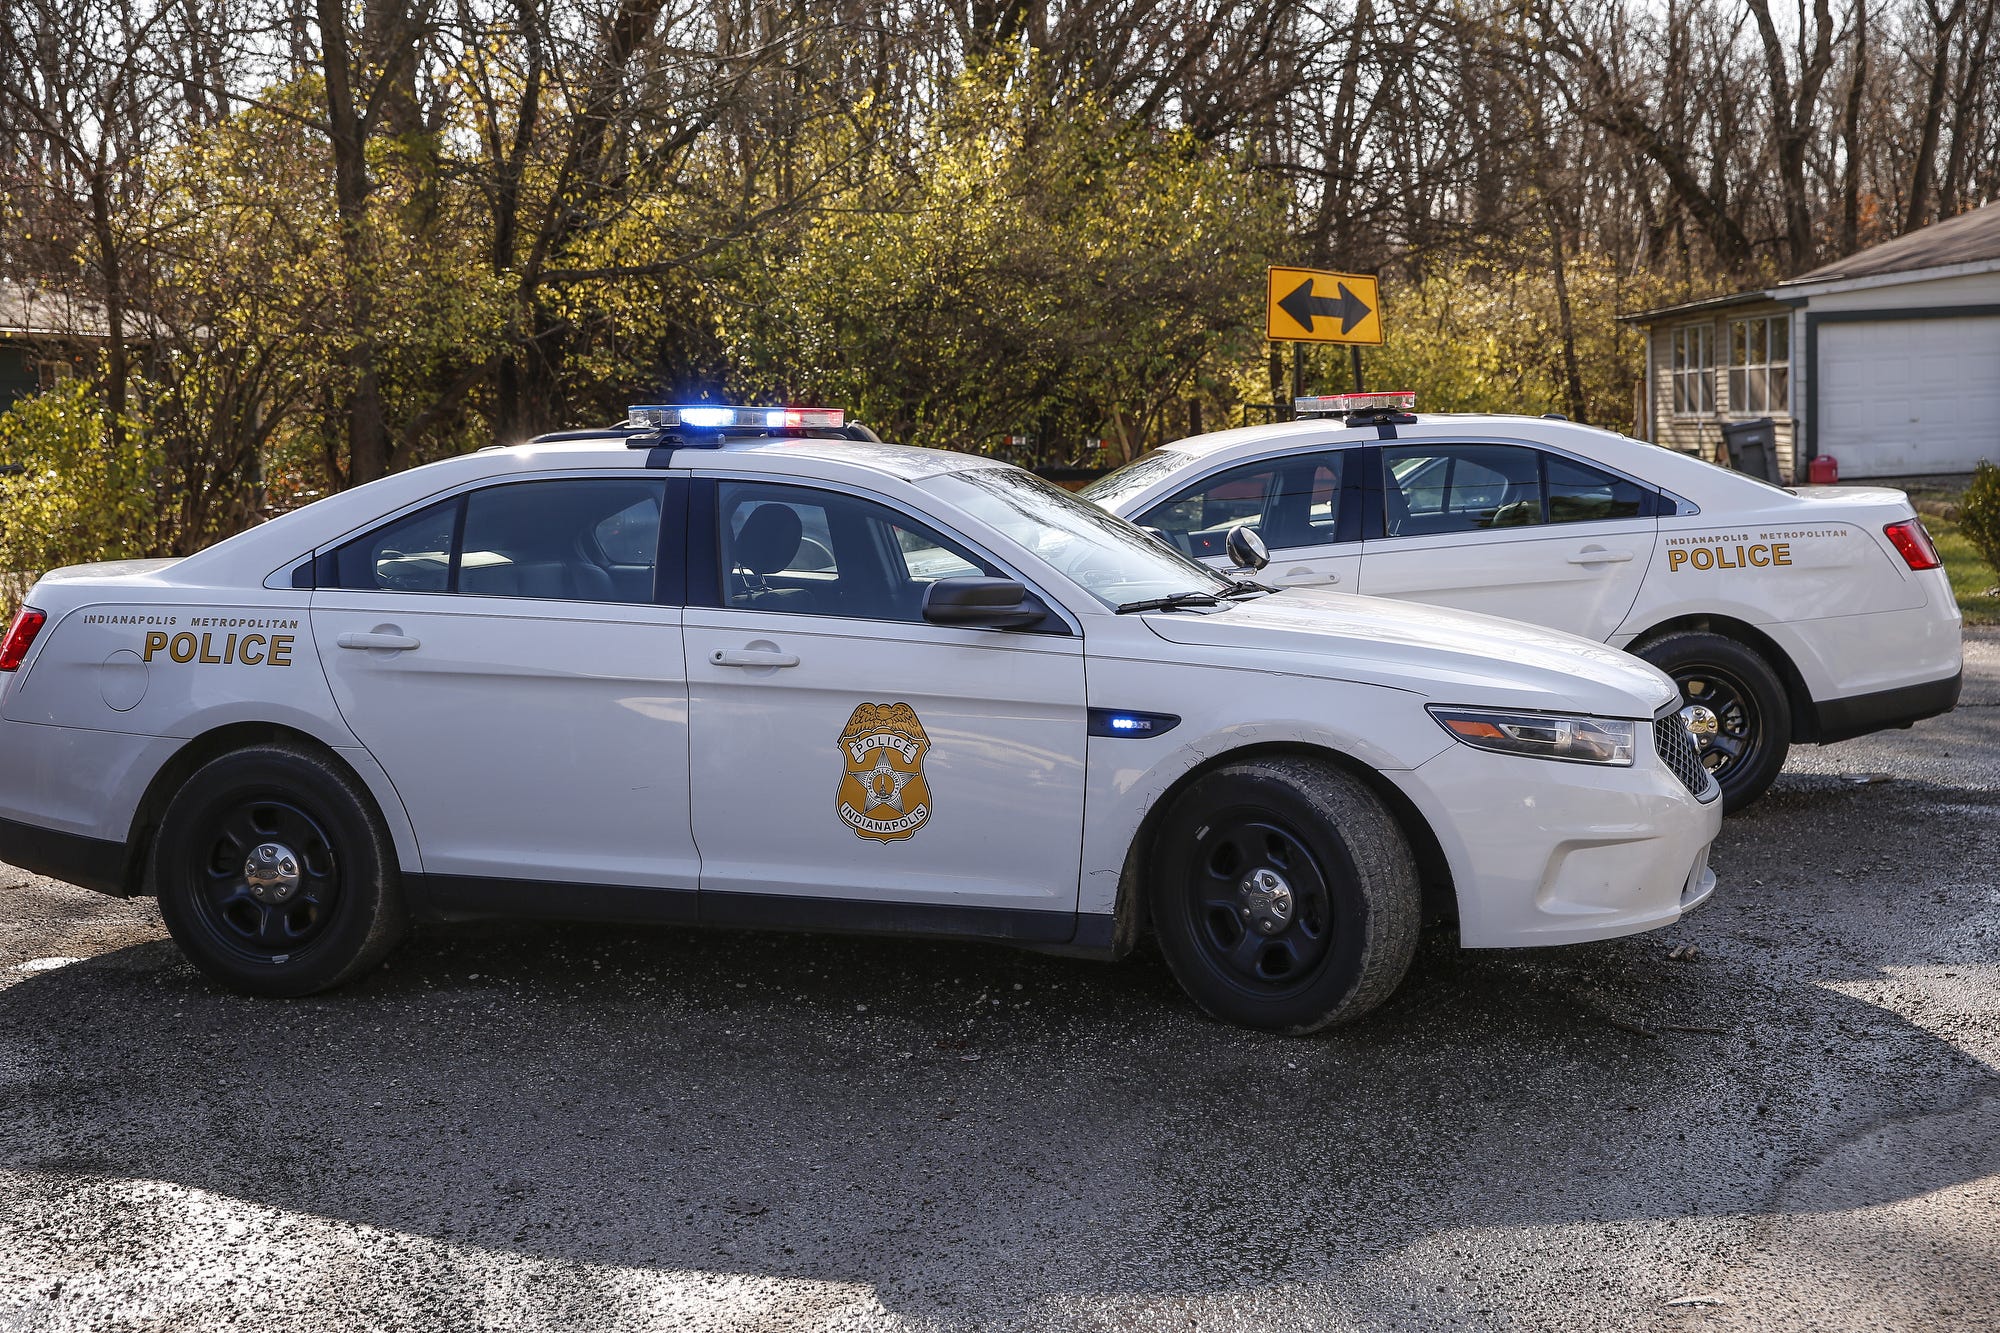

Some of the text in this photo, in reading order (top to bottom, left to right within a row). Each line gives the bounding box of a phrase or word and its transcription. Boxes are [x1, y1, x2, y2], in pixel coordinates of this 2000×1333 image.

[1665, 529, 1848, 546] INDIANAPOLIS METROPOLITAN
[1668, 543, 1793, 572] POLICE
[83, 615, 298, 629] INDIANAPOLIS METROPOLITAN
[143, 631, 295, 666] POLICE
[856, 736, 912, 754] POLICE
[842, 806, 926, 831] INDIANAPOLIS
